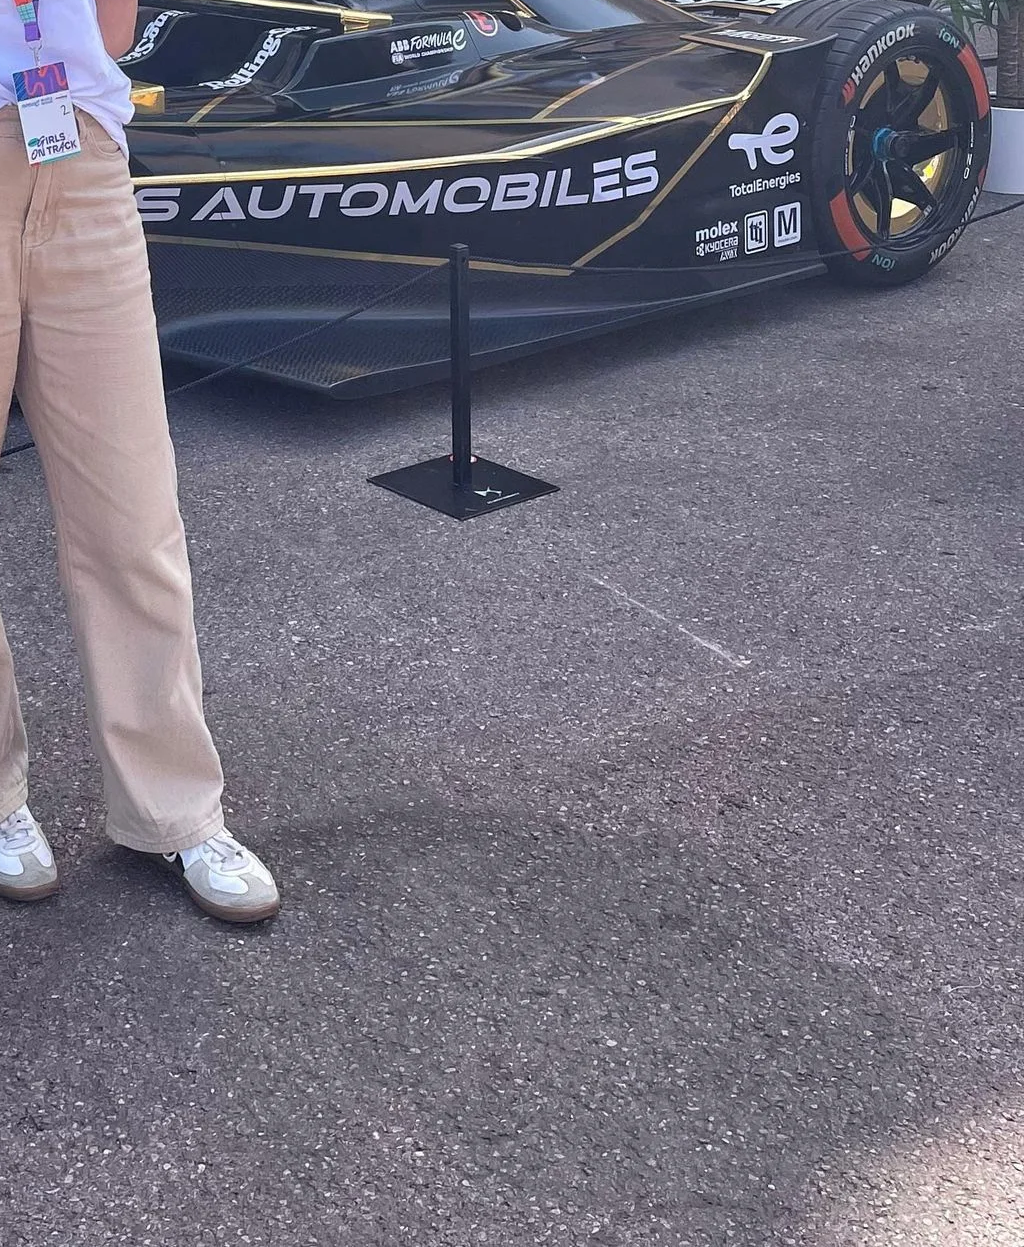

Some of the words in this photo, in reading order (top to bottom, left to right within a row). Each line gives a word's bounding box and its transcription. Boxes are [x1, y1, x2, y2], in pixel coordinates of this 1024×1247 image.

[390, 39, 410, 54] ABB
[31, 147, 46, 160] ON
[46, 140, 77, 155] TRACK
[37, 132, 66, 148] GIRLS
[137, 187, 181, 223] S
[190, 149, 660, 222] AUTOMOBILES
[729, 171, 801, 198] TotalEnergies
[695, 220, 739, 243] molex
